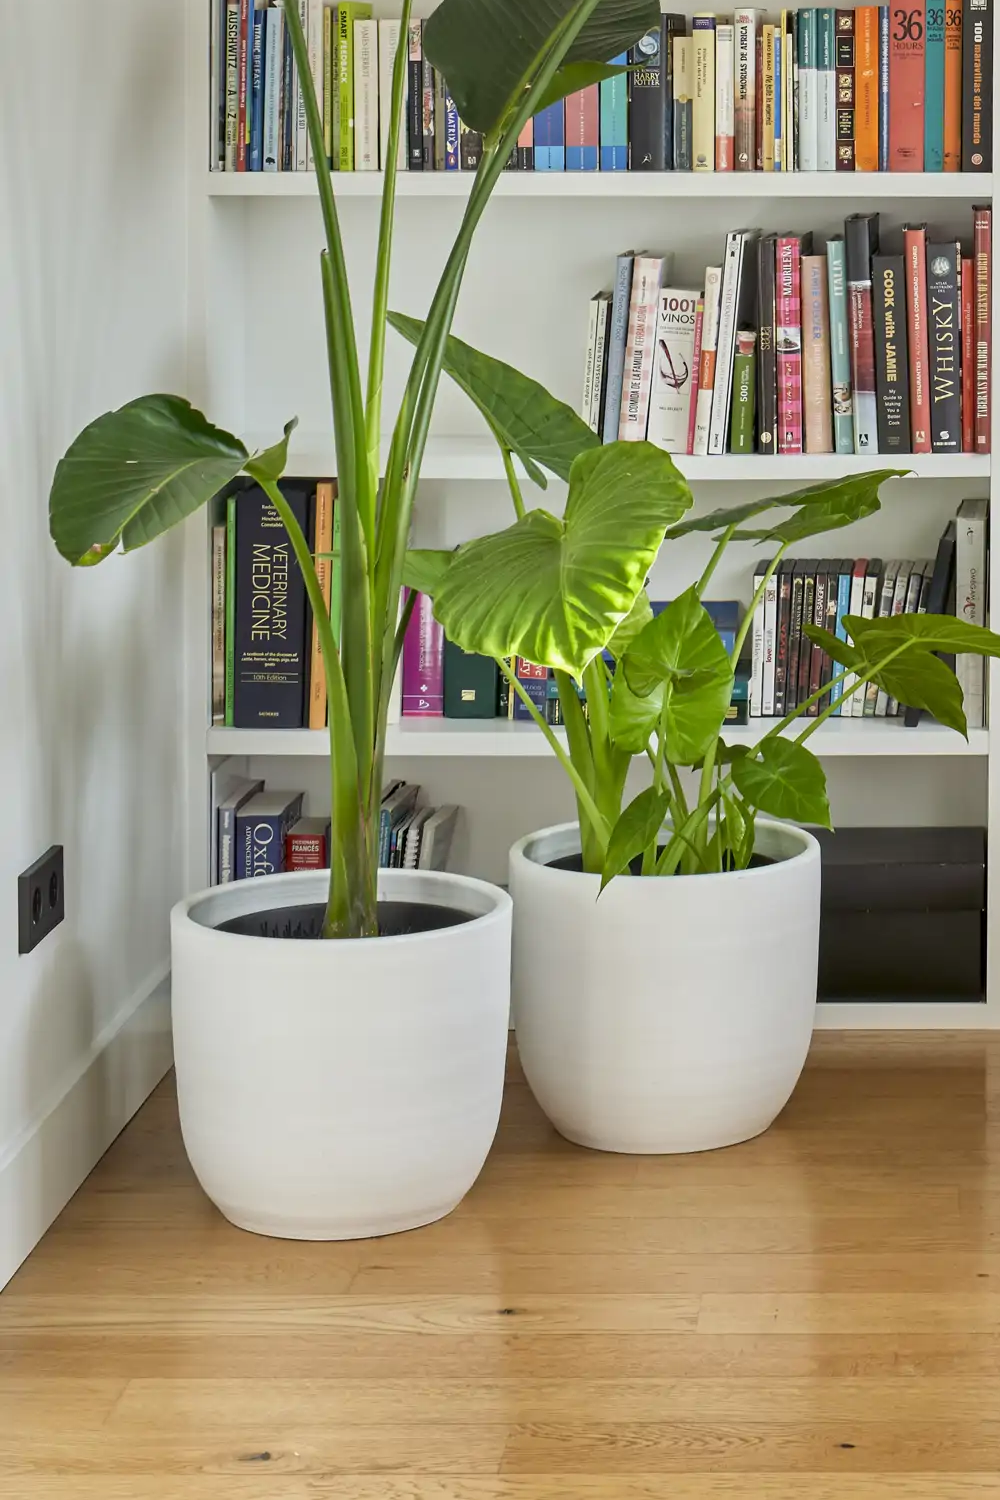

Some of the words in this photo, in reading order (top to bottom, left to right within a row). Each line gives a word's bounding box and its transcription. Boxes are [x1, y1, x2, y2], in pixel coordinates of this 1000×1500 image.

[340, 10, 348, 39] SMART
[892, 9, 924, 42] 36
[926, 8, 944, 27] 36
[945, 9, 962, 27] 36
[974, 20, 984, 43] 100
[227, 9, 238, 69] AUSCHWITZ
[253, 23, 262, 53] TITANIC
[740, 25, 749, 51] AFRICA
[892, 42, 924, 50] HOURS
[340, 39, 349, 83] FEEDBACK
[740, 51, 748, 62] DE
[973, 44, 983, 93] maravillas
[252, 54, 261, 90] BELFAST
[634, 72, 661, 82] HARRY
[634, 79, 661, 87] POTTER
[739, 63, 749, 100] MEMORIAS
[973, 94, 983, 110] del
[973, 111, 983, 145] mundo
[782, 244, 794, 296] MADRILEÑA
[811, 266, 820, 297] JAMIE
[832, 259, 844, 297] ITALIA
[977, 252, 988, 282] MADRID
[883, 269, 895, 308] COOK
[913, 276, 921, 314] COMUNIDAD
[662, 297, 696, 313] 1001
[662, 313, 696, 325] VINOS
[812, 300, 821, 339] OLIVER
[914, 313, 921, 322] LA
[977, 293, 988, 325] TAVERNS
[635, 322, 645, 346] FERRAN
[884, 310, 895, 338] with
[914, 322, 921, 330] EN
[633, 349, 643, 372] FAMILIA
[885, 341, 897, 382] JAMIE
[932, 295, 955, 403] WHISKY
[977, 341, 988, 371] MADRID
[632, 372, 641, 381] LA
[691, 355, 699, 385] BALI
[915, 361, 923, 406] RESTAURANTES
[977, 371, 987, 381] DE
[631, 381, 640, 390] DE
[739, 384, 749, 403] 500
[976, 381, 988, 419] TABERNAS
[629, 390, 639, 413] COMIDA
[628, 412, 638, 422] LA
[250, 542, 270, 642] MEDICINE
[272, 542, 288, 641] VETERINARY
[816, 583, 825, 610] SANGRE
[244, 825, 252, 864] ADVANCED
[292, 844, 320, 853] FRANCÉS
